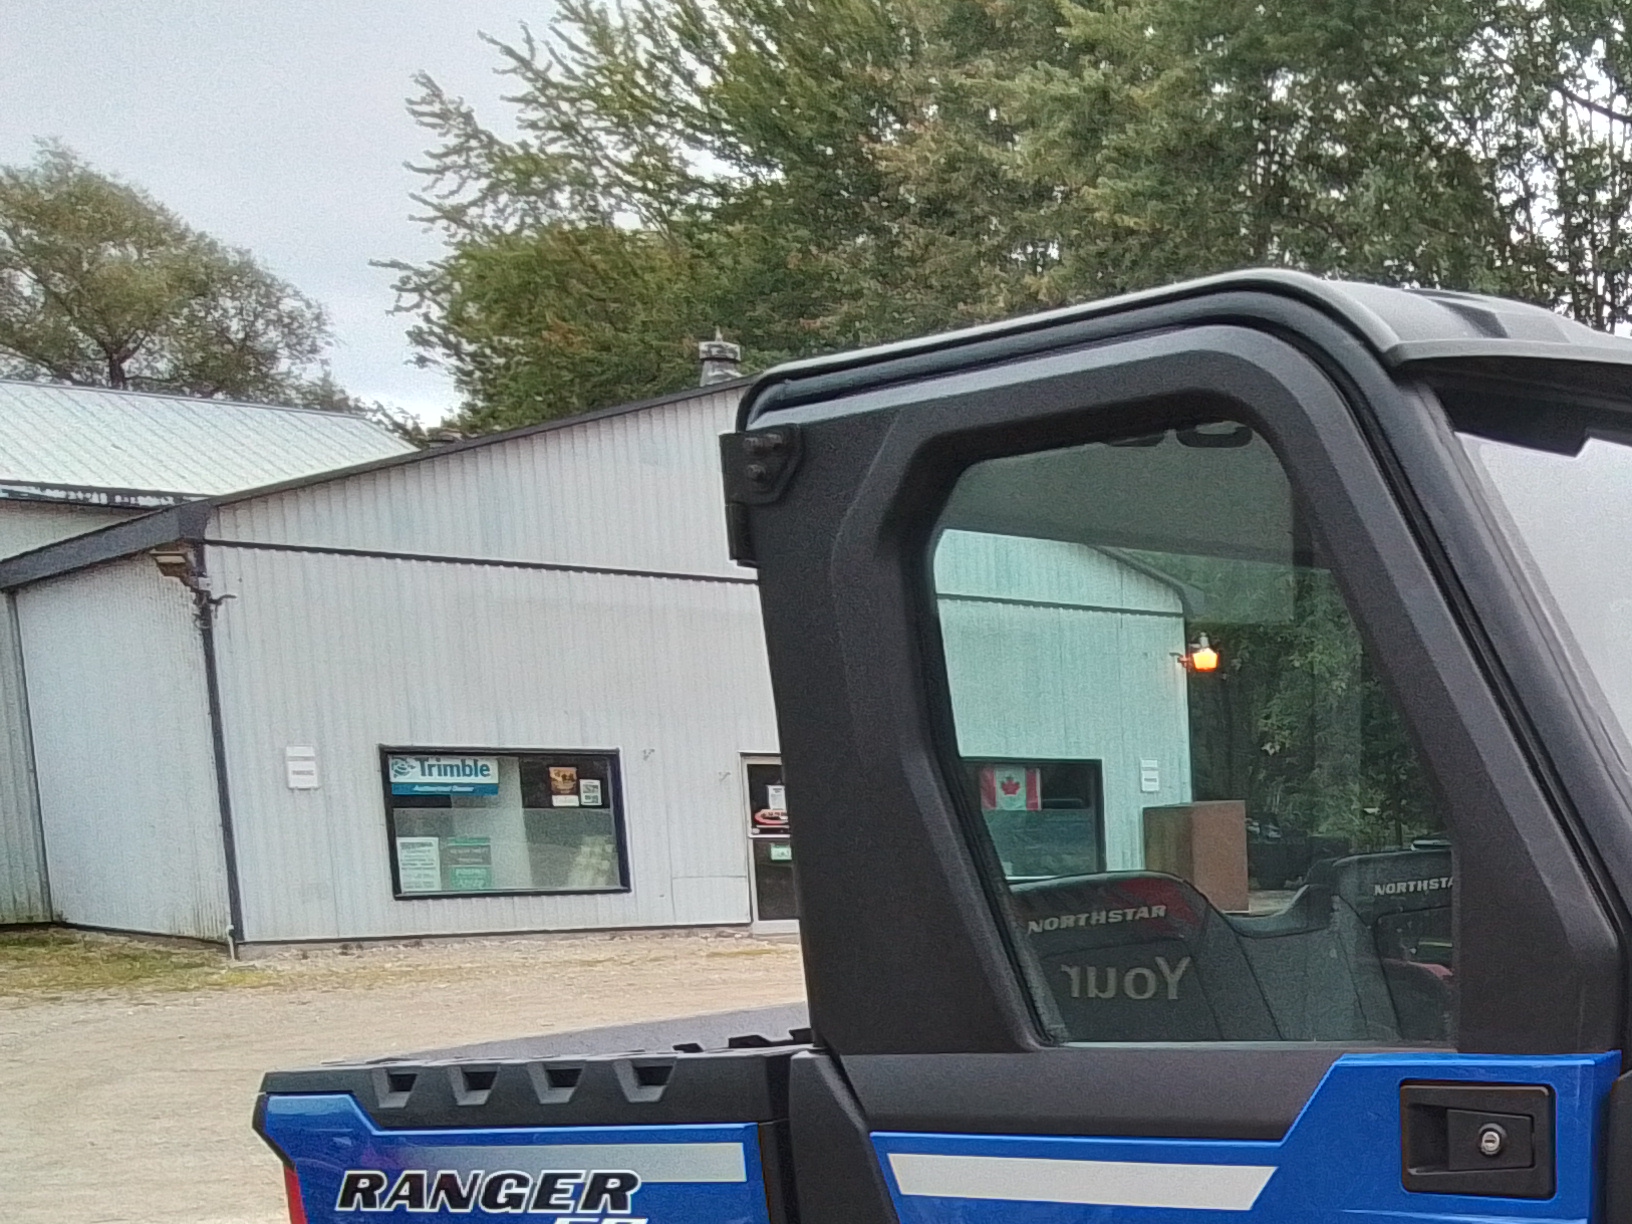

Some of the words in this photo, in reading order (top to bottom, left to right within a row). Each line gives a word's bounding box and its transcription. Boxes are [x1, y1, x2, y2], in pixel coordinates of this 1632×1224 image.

[415, 757, 491, 778] Trimble
[1027, 905, 1167, 935] NORTHSTAR
[335, 1170, 642, 1214] RANGER
